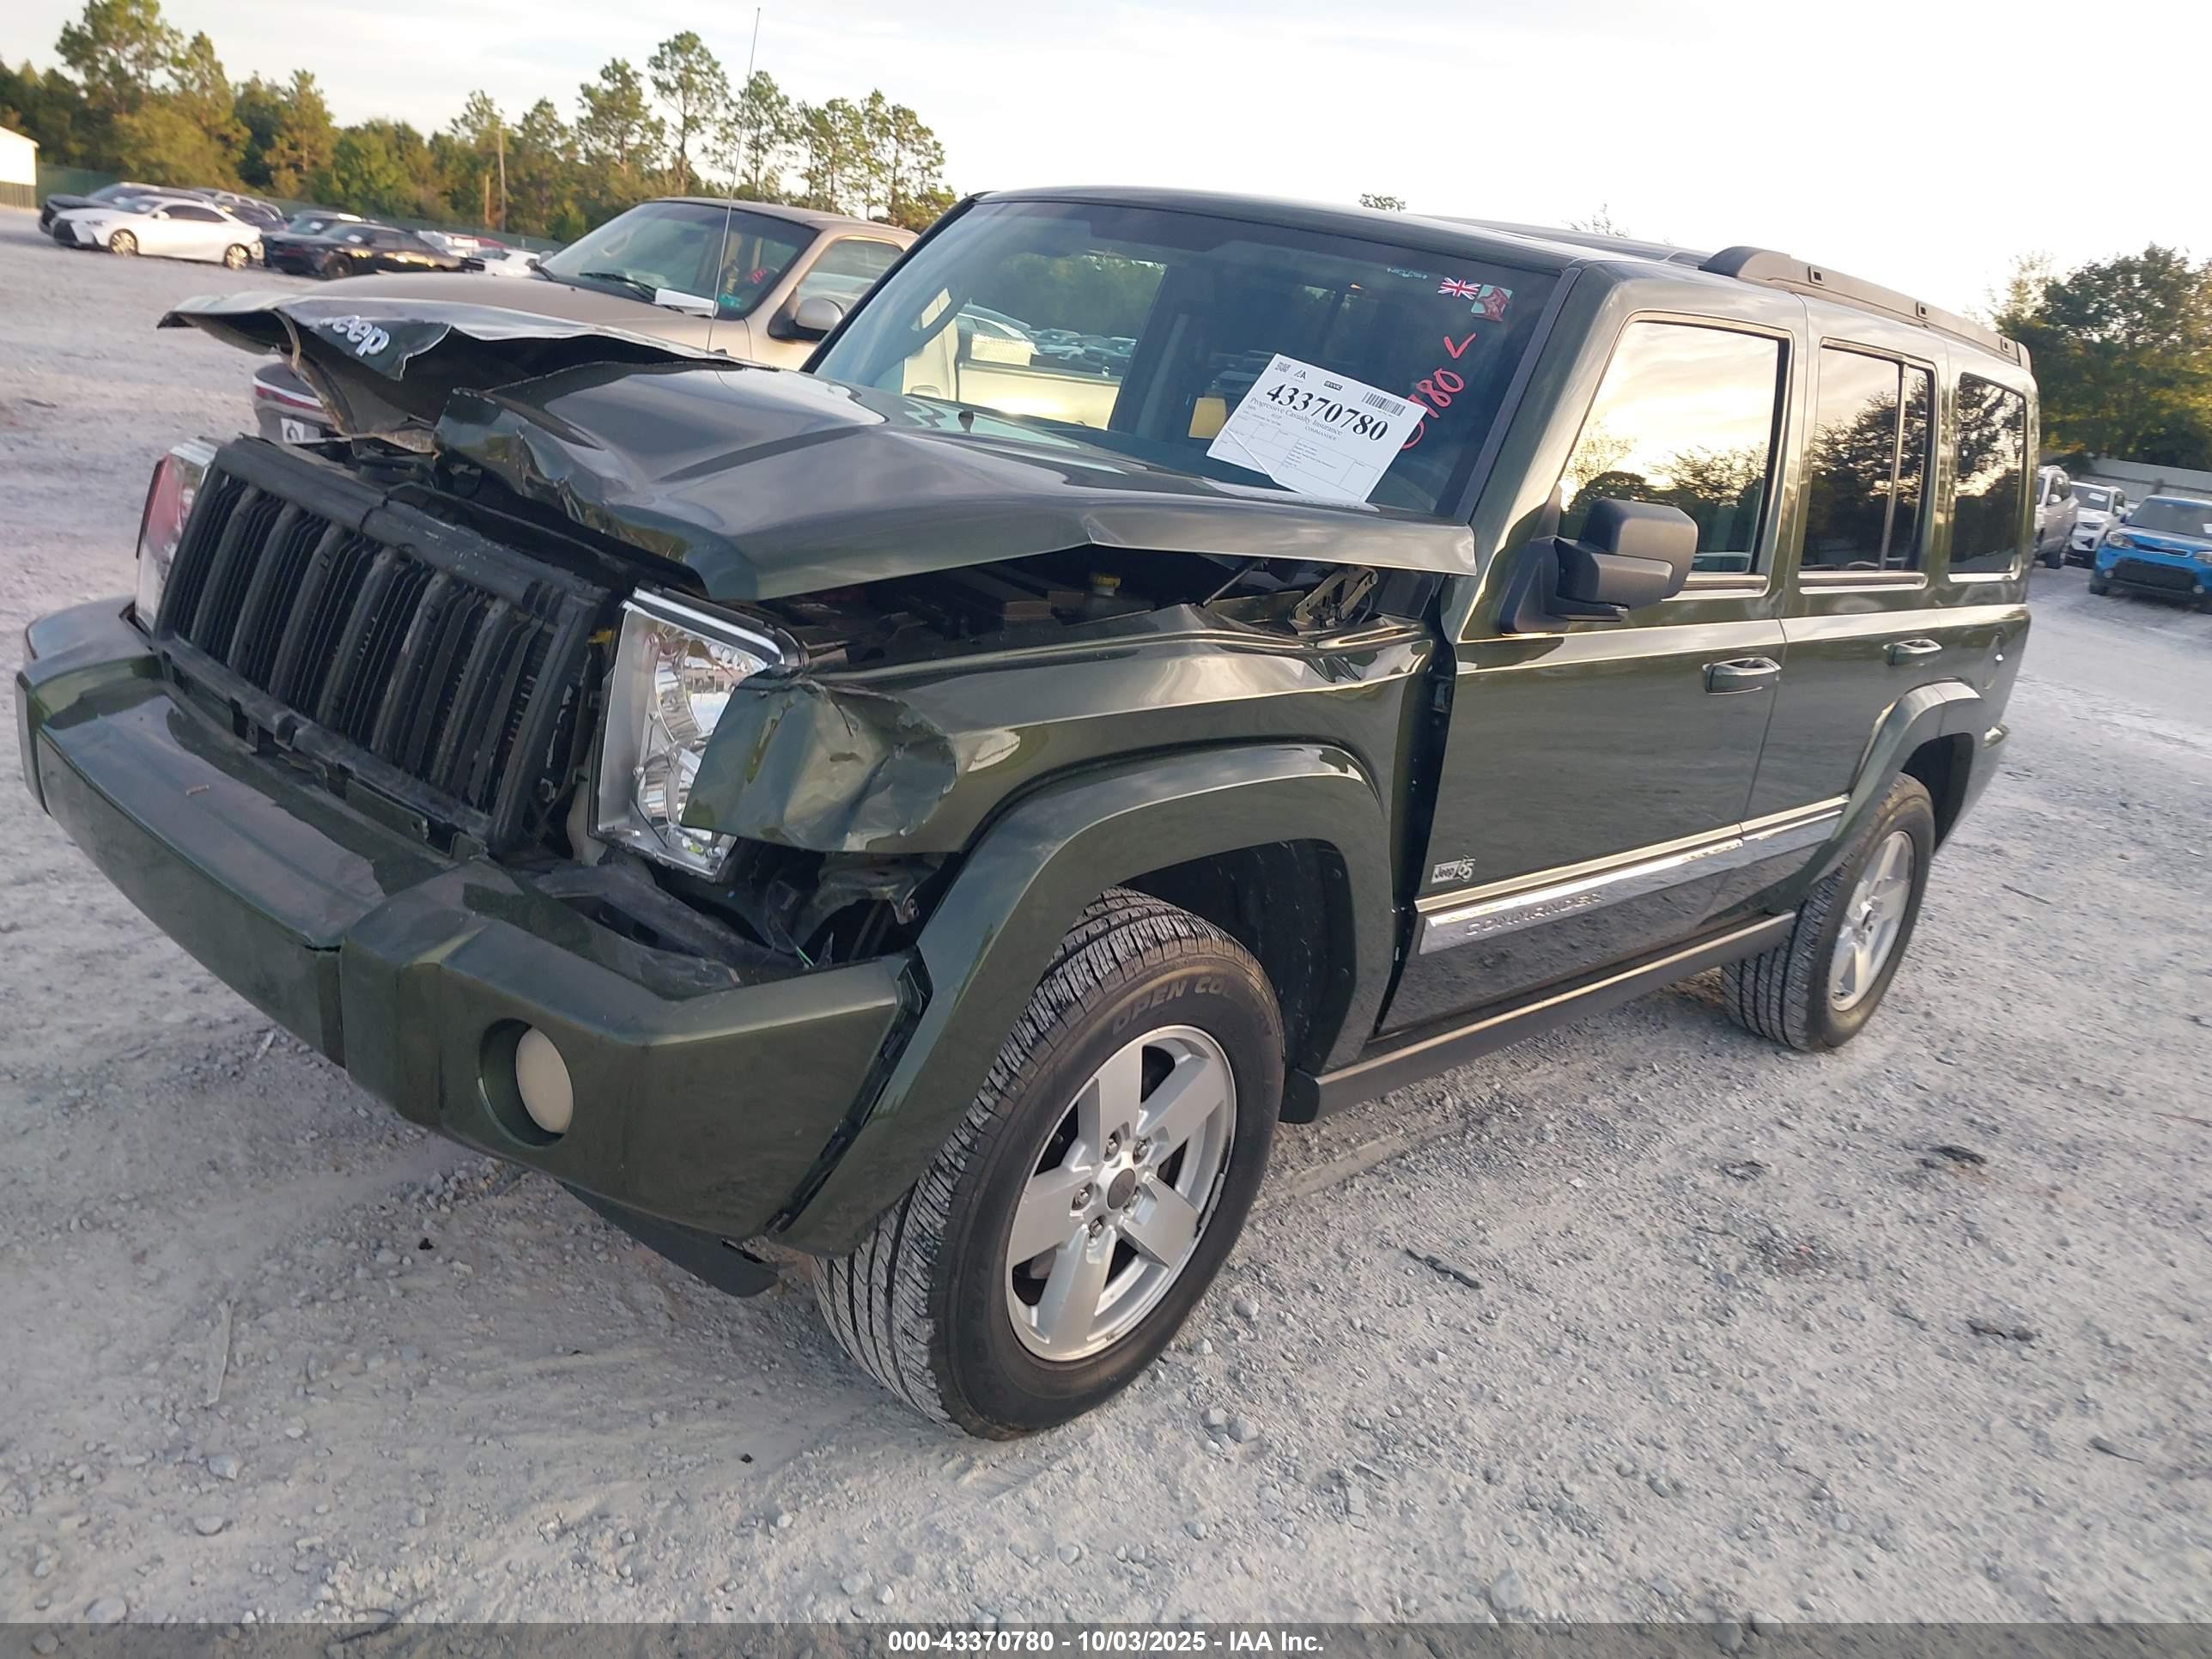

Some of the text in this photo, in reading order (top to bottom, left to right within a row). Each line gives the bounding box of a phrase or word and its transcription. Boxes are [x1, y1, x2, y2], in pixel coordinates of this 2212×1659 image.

[1250, 397, 1285, 413] Progressive
[1285, 409, 1310, 424] Casualty
[1312, 419, 1343, 435] Insurance
[1267, 383, 1389, 441] 43370780
[1434, 864, 1455, 881] Jeep
[1465, 891, 1603, 935] COMMANDER
[1113, 979, 1188, 1035] OPEN
